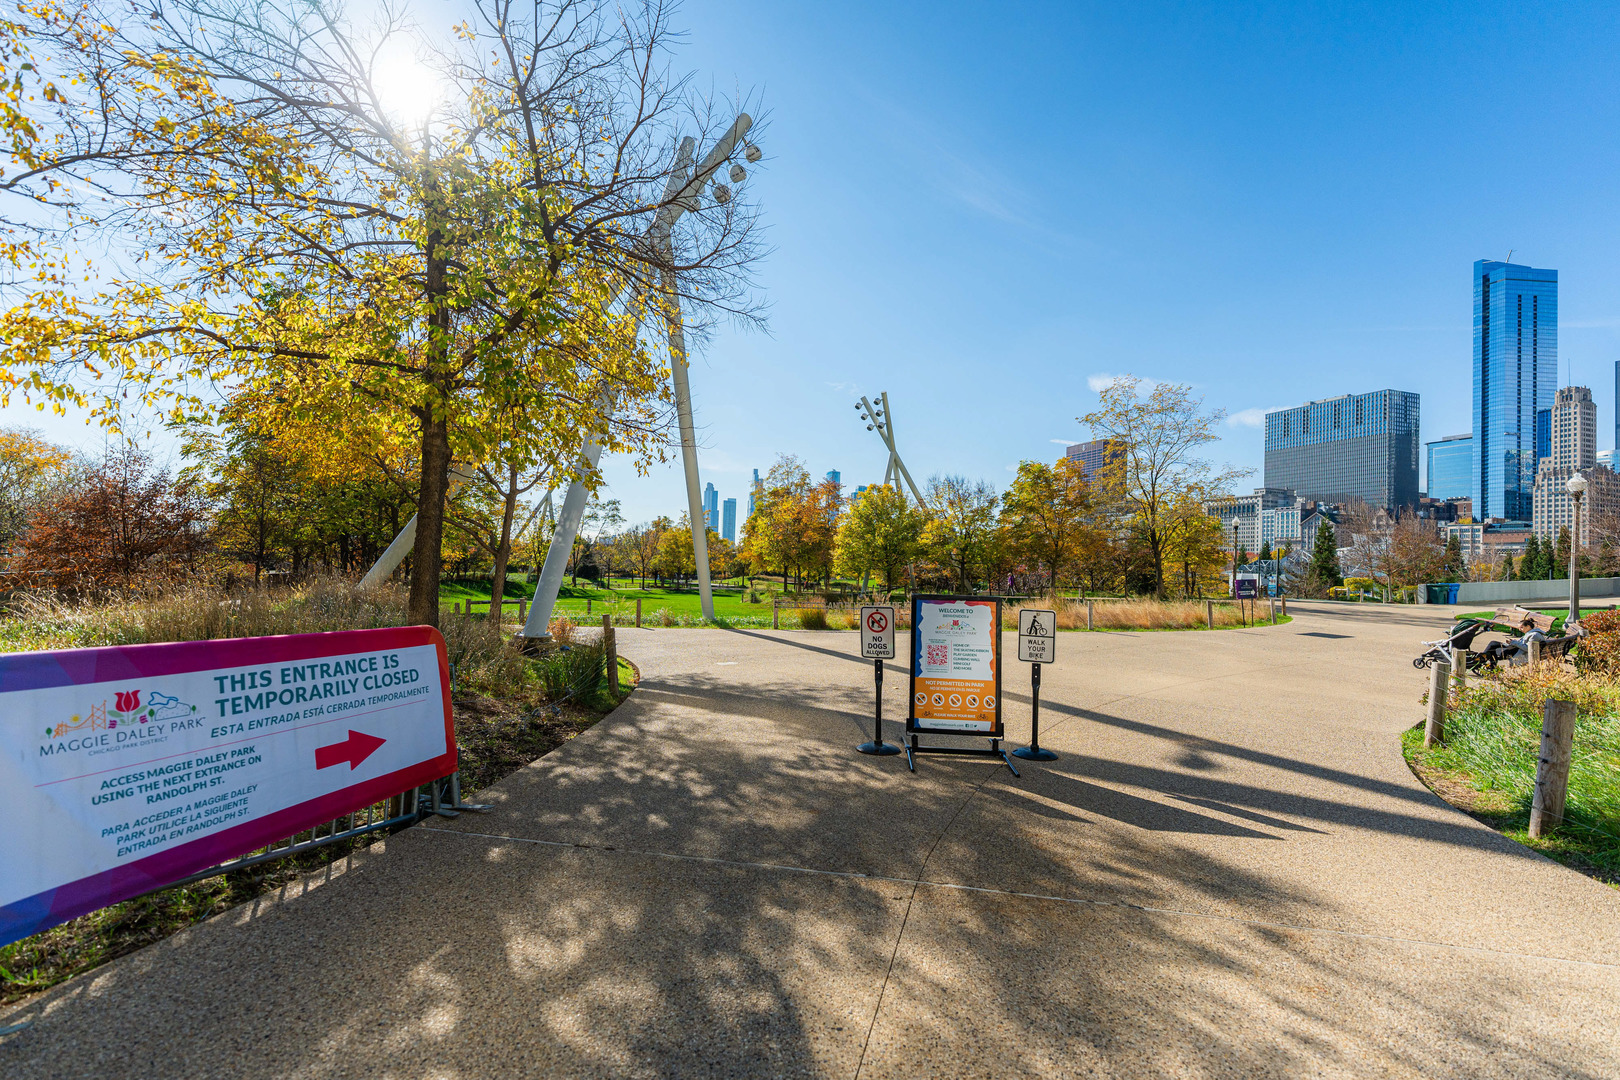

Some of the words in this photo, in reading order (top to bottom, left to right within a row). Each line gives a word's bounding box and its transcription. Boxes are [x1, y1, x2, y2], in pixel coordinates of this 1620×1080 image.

[214, 670, 272, 693] THIS
[281, 657, 377, 684] ENTRANCE
[382, 654, 399, 669] IS
[215, 678, 359, 717] TEMPORARILY
[363, 669, 419, 690] CLOSED
[211, 724, 244, 738] ESTA
[248, 711, 300, 730] ENTRADA
[303, 706, 324, 719] ESTÁ
[327, 699, 366, 714] CERRADA
[368, 686, 430, 705] TEMPORALMENTE
[40, 734, 109, 757] MAGGIE
[117, 725, 165, 743] DALEY
[171, 718, 204, 732] PARK
[88, 745, 120, 756] CHICAGO
[140, 736, 168, 746] DISTRICT
[92, 788, 134, 806] USING
[137, 781, 159, 794] THE
[163, 773, 192, 787] NEXT
[195, 760, 246, 779] EXTRANCE
[248, 755, 262, 764] ON
[100, 772, 145, 790] ACCESS
[147, 760, 193, 778] MAGGIE
[196, 752, 228, 767] DALEY
[231, 745, 256, 758] PARK
[146, 780, 207, 804] RANDOLPH
[210, 776, 225, 787] ST.
[101, 822, 129, 838] PARA
[133, 806, 183, 828] ACCEDER
[185, 804, 192, 813] A
[194, 793, 229, 810] MAGGIE
[230, 784, 258, 799] DALEY
[117, 828, 146, 845] PARK
[148, 816, 187, 835] UTILICE
[190, 812, 202, 822] LA
[204, 797, 249, 817] SIGUIENTE
[117, 835, 167, 858] ENTRADA
[169, 829, 184, 840] EN
[186, 812, 236, 834] RANDOLPH
[237, 807, 250, 817] ST.
